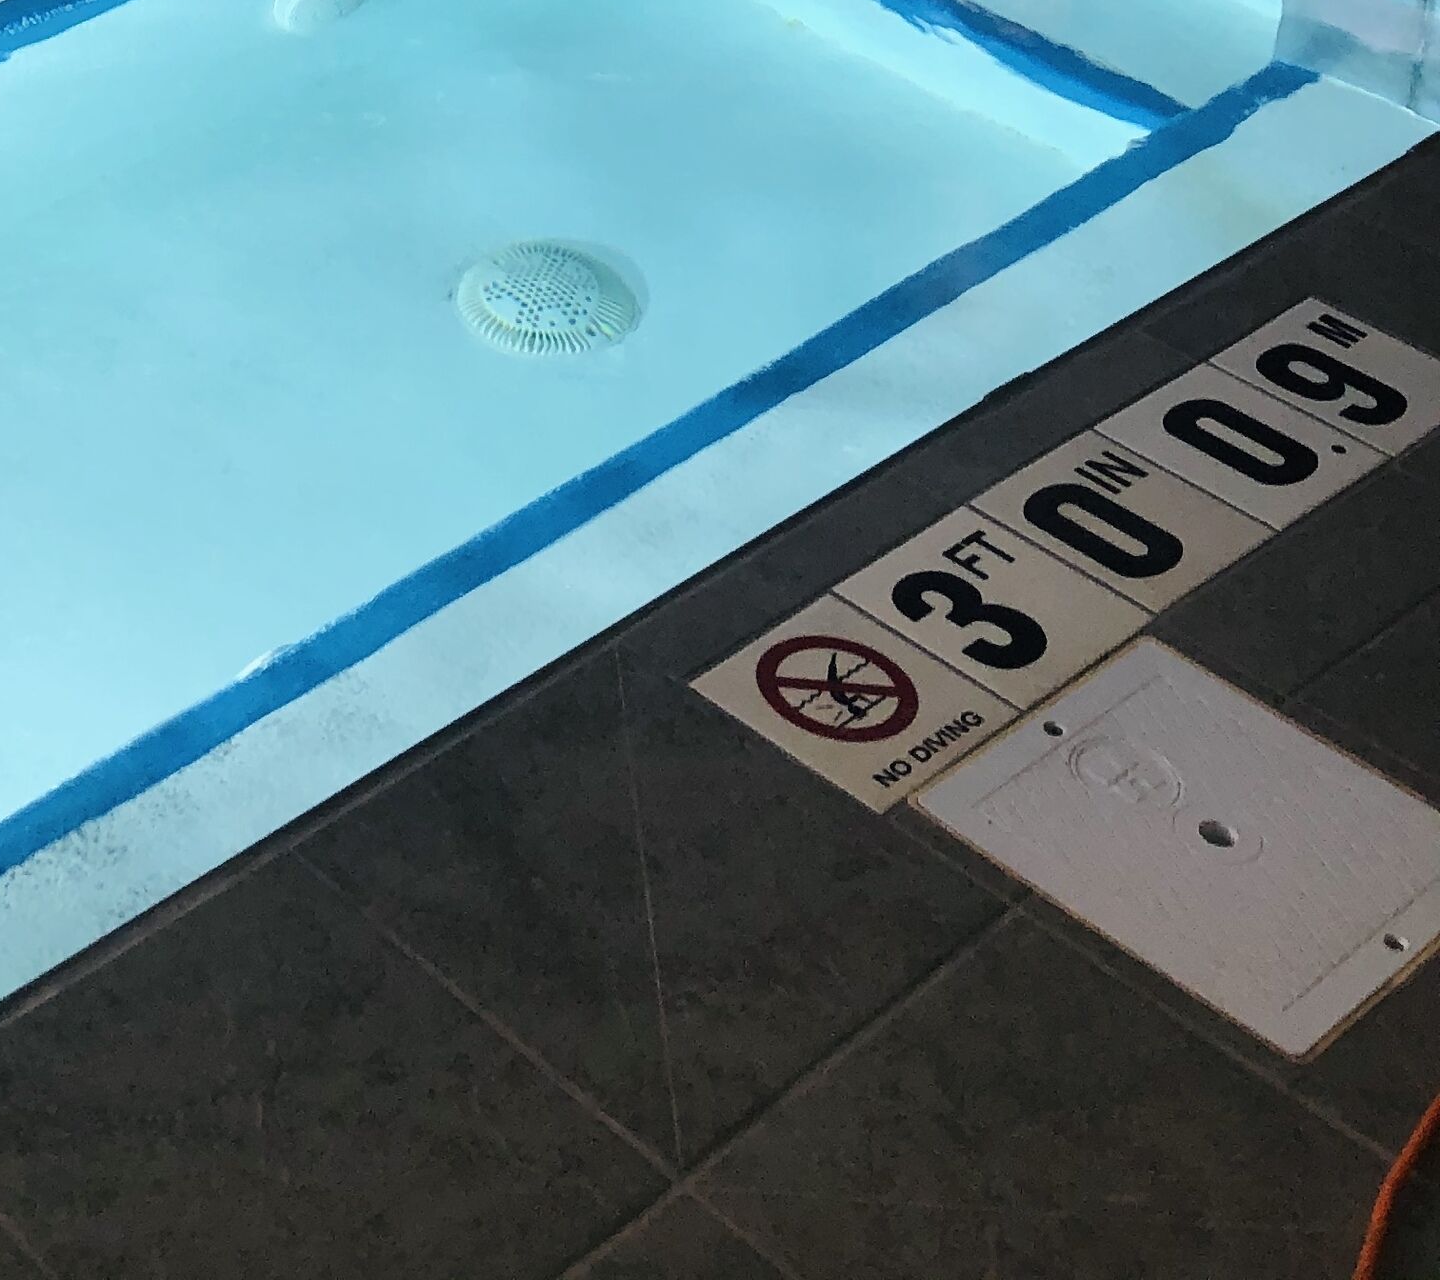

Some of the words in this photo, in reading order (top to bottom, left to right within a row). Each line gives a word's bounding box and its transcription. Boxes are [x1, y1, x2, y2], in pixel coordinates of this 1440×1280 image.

[891, 569, 1048, 670] 3
[1022, 482, 1185, 579] 0
[872, 759, 913, 788] NO
[908, 710, 986, 763] DIVING
